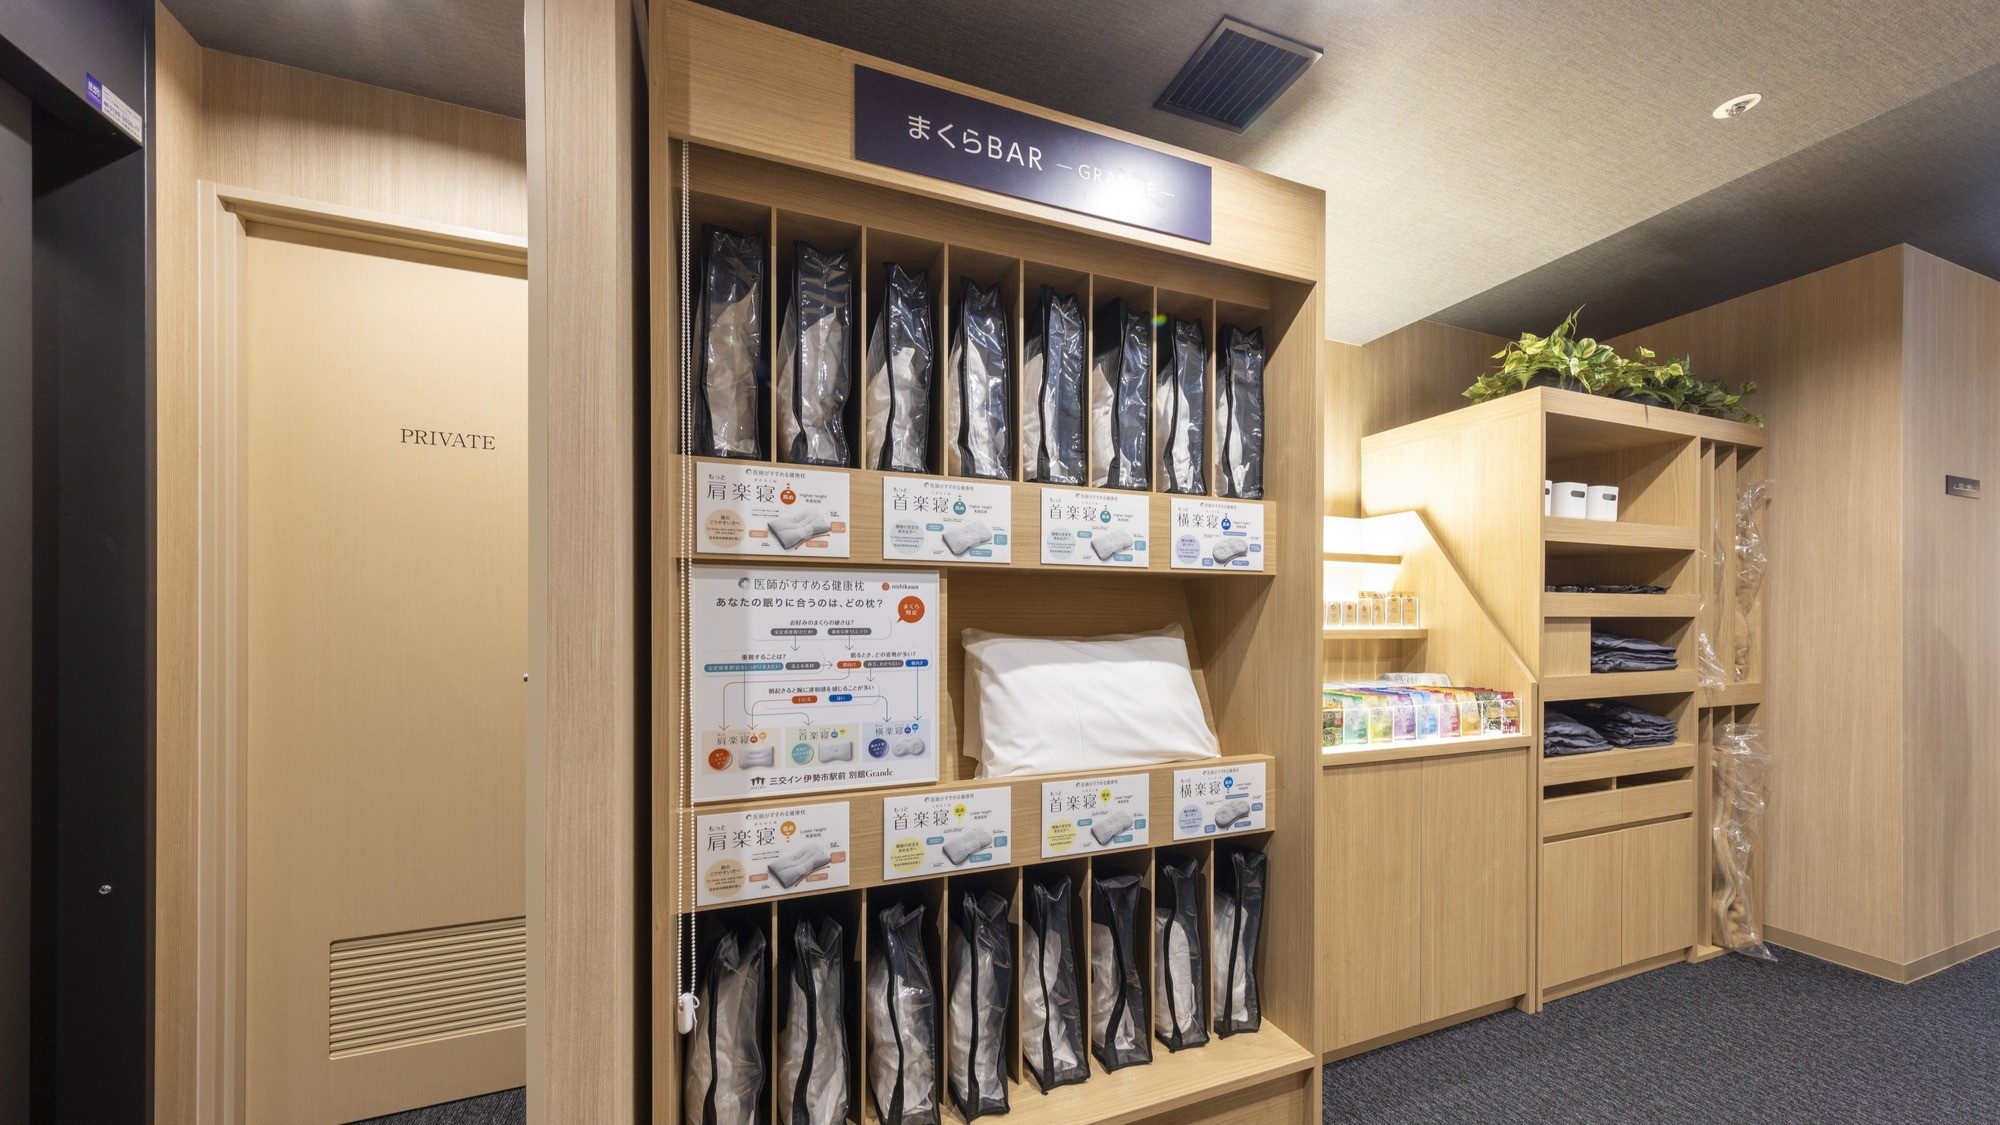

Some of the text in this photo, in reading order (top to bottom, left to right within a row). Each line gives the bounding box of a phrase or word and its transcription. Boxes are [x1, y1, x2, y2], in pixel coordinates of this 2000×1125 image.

[907, 115, 1043, 171] まくらBAR
[400, 428, 496, 450] PRIVATE
[752, 470, 806, 479] 医師がすすめる健康枕
[707, 482, 775, 504] 肩楽寝
[892, 494, 949, 514] 首楽寝
[1049, 504, 1097, 522] 首楽寝
[1177, 512, 1219, 529] 横楽寝
[754, 578, 864, 592] 医師がすすめる健康枕
[715, 597, 884, 609] あなたの眠りに合うのは、どの枕？
[848, 768, 894, 779] 別館Grande
[1180, 781, 1221, 799] 横楽寝
[1049, 793, 1097, 813] 首楽寝
[709, 824, 726, 832] もっと
[893, 809, 950, 831] 首楽寝
[707, 827, 776, 851] 肩楽寝
